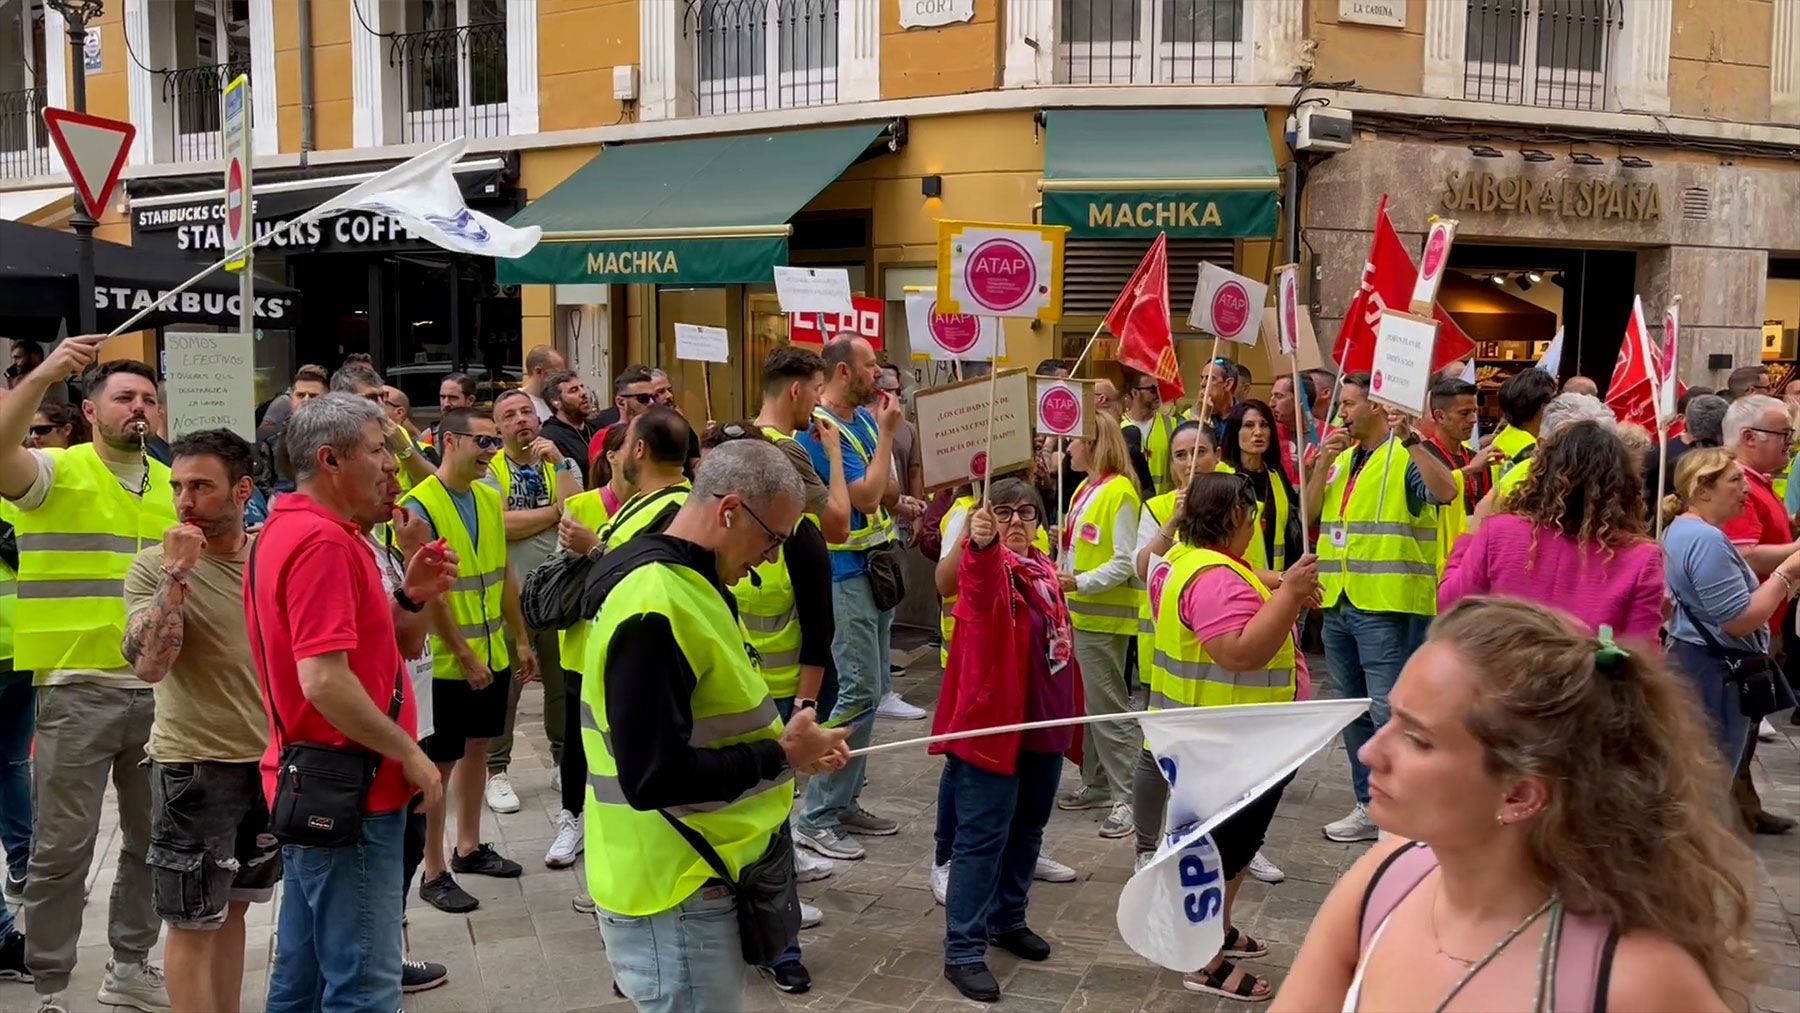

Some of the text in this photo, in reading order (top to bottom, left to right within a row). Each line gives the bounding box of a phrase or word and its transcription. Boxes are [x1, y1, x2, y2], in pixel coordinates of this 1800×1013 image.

[1353, 2, 1393, 17] LA CADENA
[1442, 170, 1535, 213] SABOR
[1562, 177, 1663, 221] ESPAÑA
[139, 204, 209, 226] STARBUCKS
[1088, 201, 1223, 227] MACHKA
[587, 250, 679, 275] MACHKA
[975, 257, 1027, 275] ATAP
[1217, 293, 1246, 311] ATAP
[168, 337, 218, 350] SOMOS
[1045, 398, 1074, 410] ATAP
[935, 426, 960, 439] PALMA
